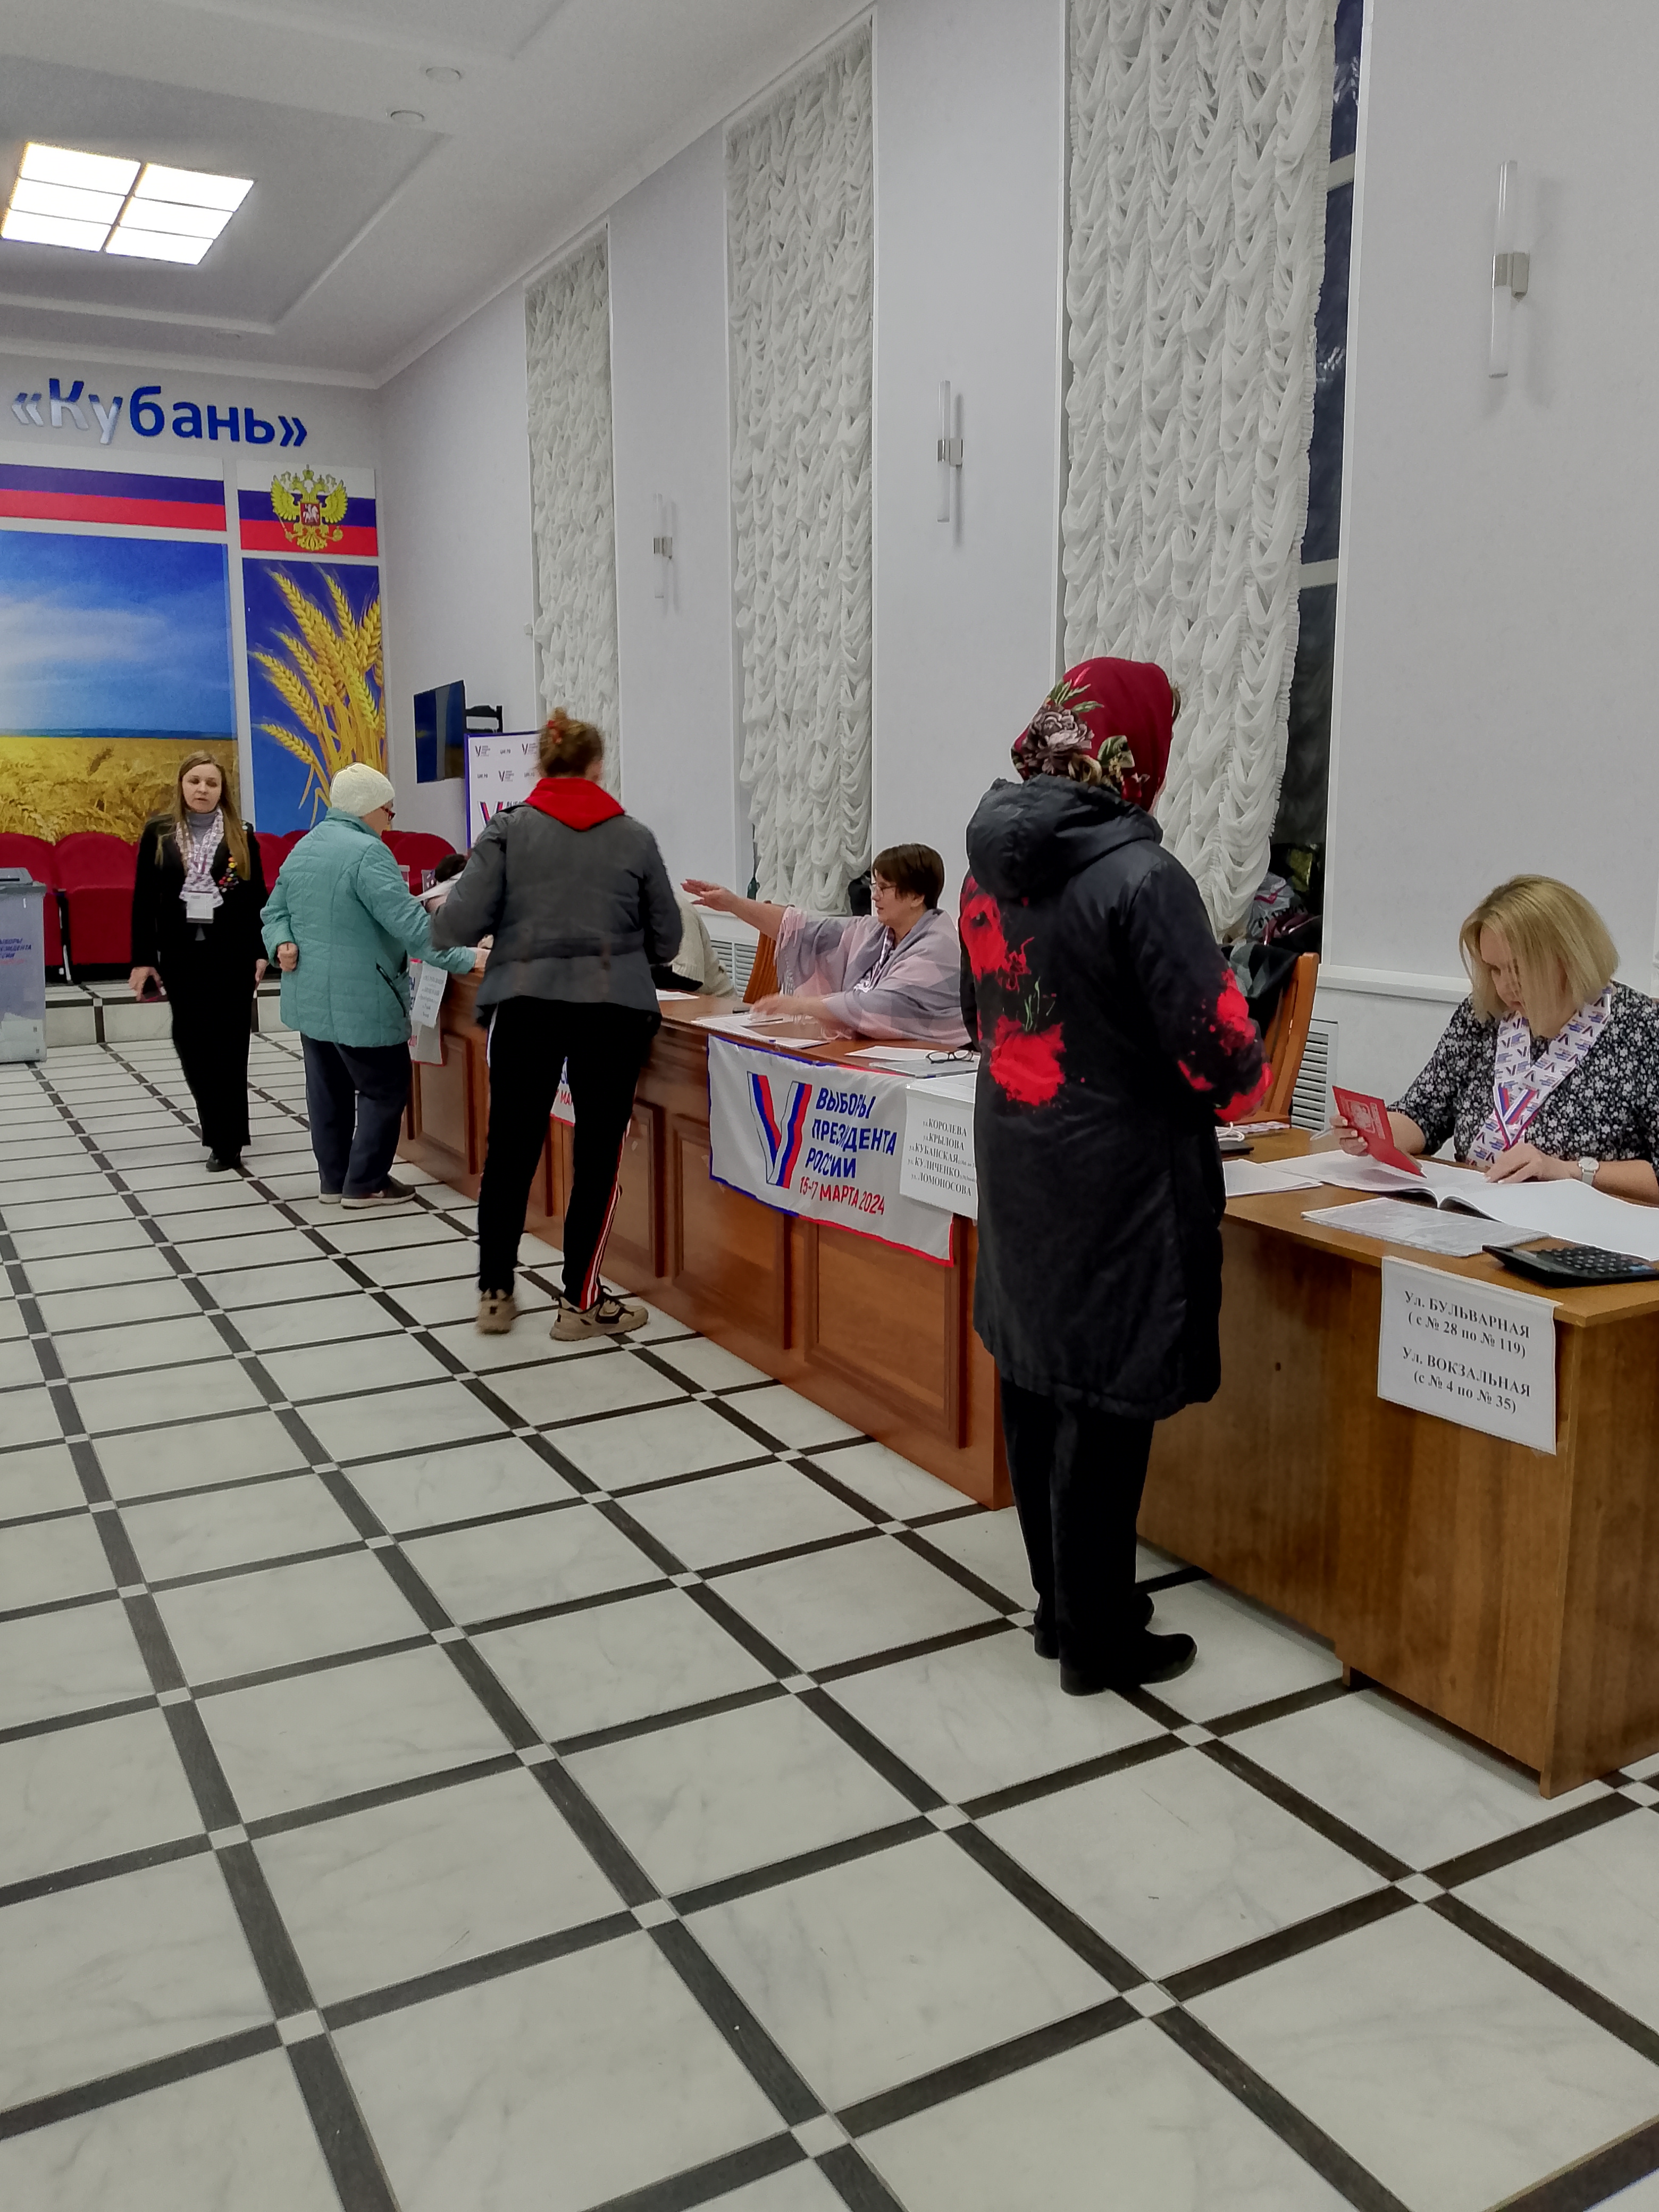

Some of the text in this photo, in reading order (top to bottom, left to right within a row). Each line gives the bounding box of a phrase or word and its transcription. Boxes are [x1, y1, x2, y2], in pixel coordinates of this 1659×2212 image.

[11, 378, 308, 447] «Кубань»
[816, 1087, 876, 1119] ВЫБОРЫ
[811, 1118, 898, 1156] ПРЕЗИДЕНТА
[805, 1147, 857, 1178] РОССИИ
[819, 1184, 860, 1208] МАРТА
[858, 1191, 885, 1216] 2024
[918, 1172, 971, 1196] ЛОМОНОСОВА
[1404, 1291, 1530, 1338] Ул. БУЛЬВАРНАЯ
[1443, 1321, 1458, 1336] 28
[1461, 1329, 1477, 1342] по
[1500, 1338, 1526, 1359] 119)
[1403, 1346, 1530, 1397] Ул. ВОКЗАЛЬНАЯ
[1457, 1386, 1473, 1398] по
[1496, 1395, 1516, 1414] 35)
